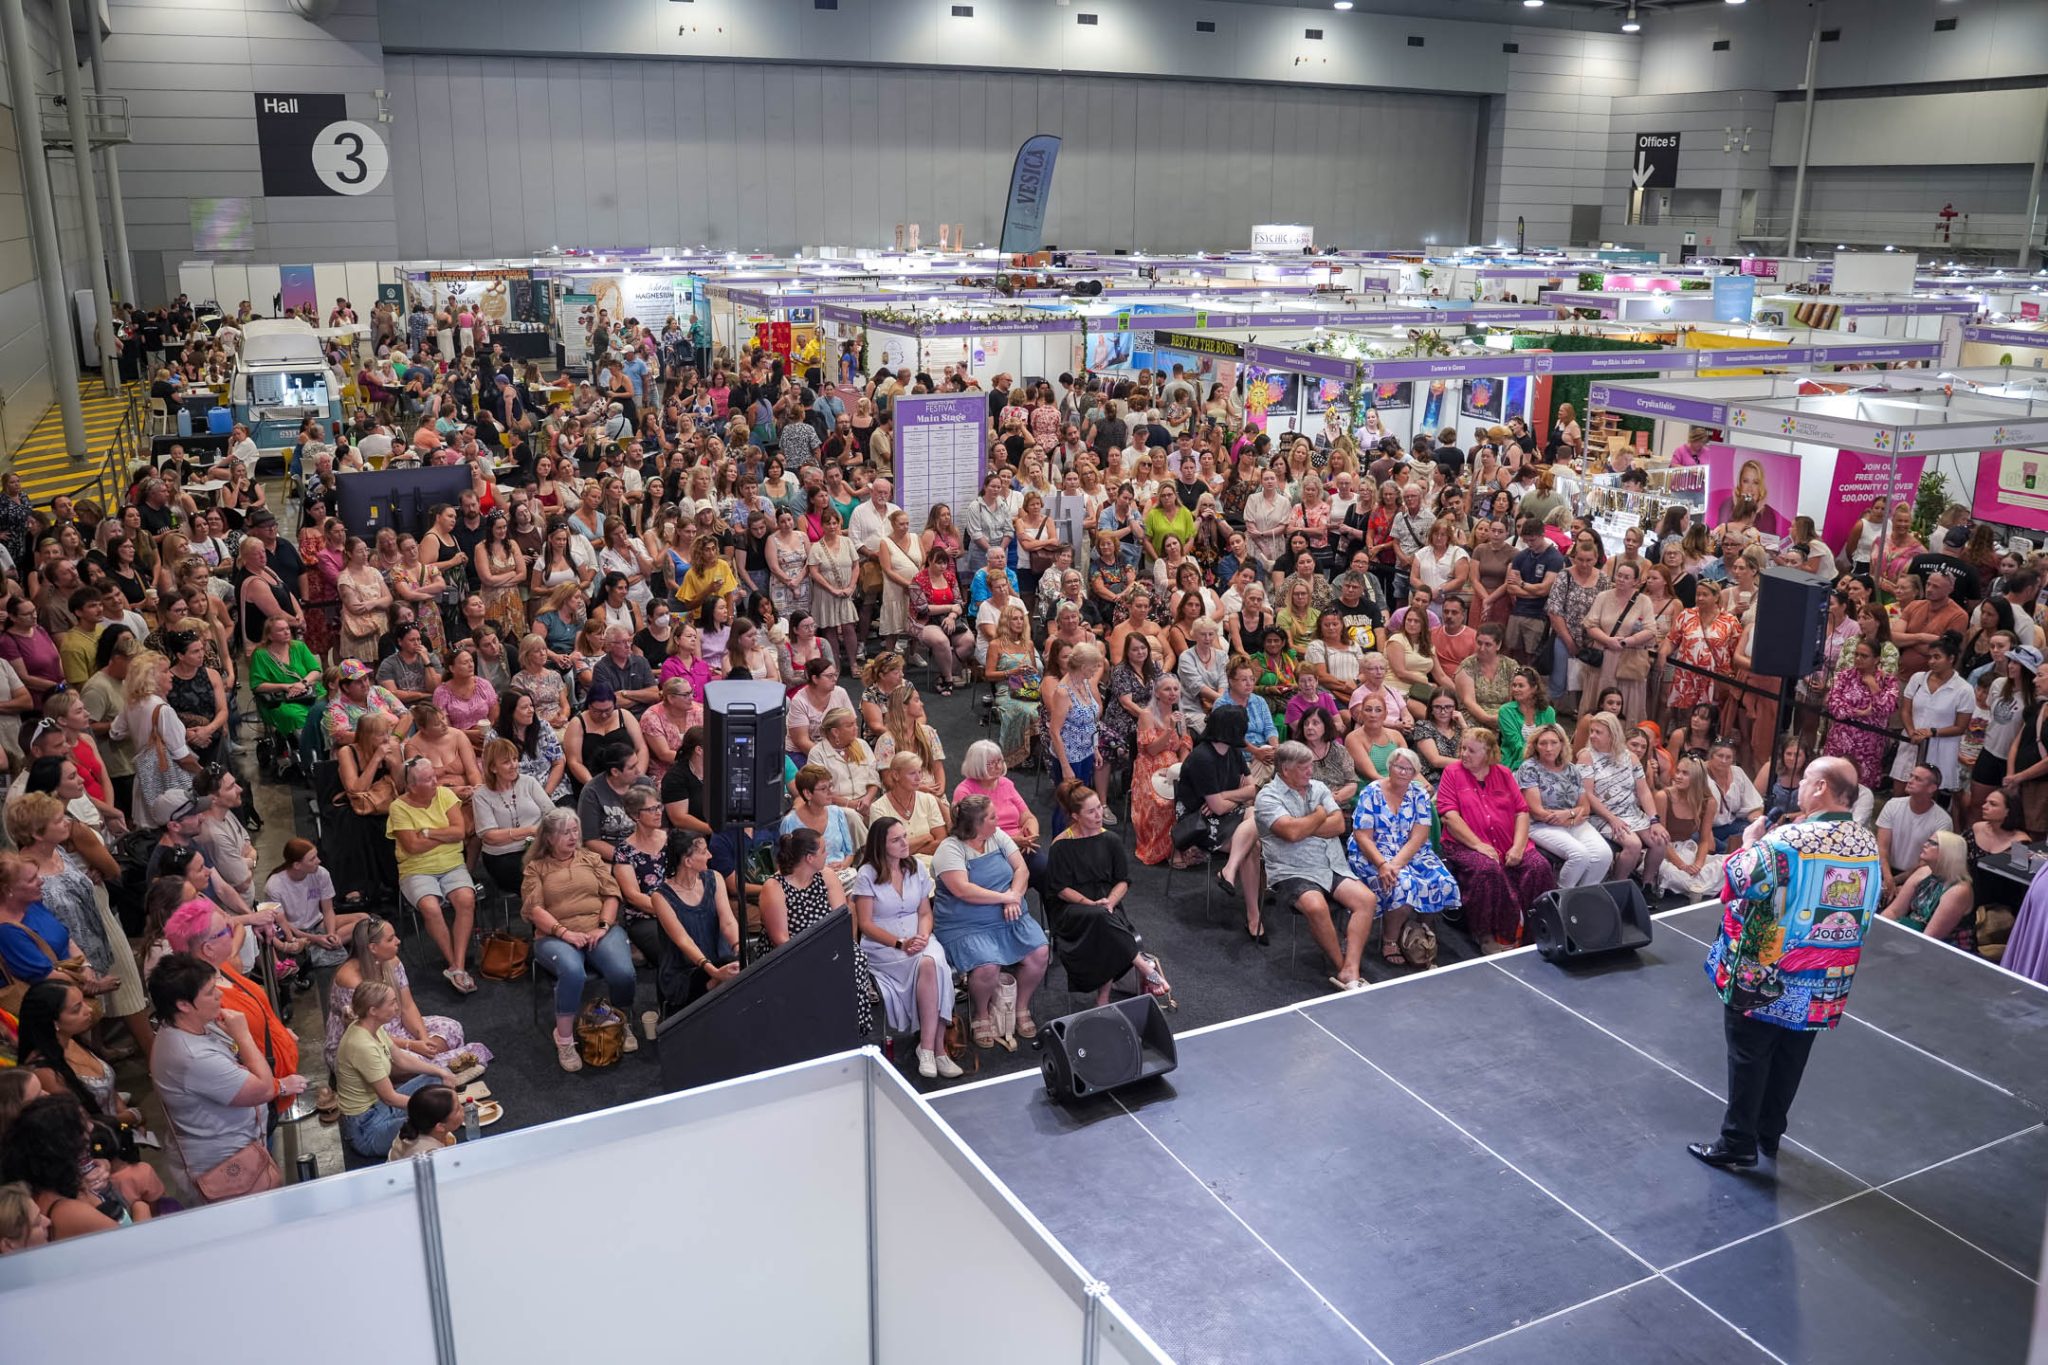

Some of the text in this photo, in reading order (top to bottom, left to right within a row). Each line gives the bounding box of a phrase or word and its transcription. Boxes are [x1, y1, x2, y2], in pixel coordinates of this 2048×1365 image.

[263, 98, 299, 114] Hall
[1639, 136, 1677, 148] Office 5
[333, 132, 368, 185] 3
[1016, 150, 1046, 204] VESICA
[1171, 334, 1189, 347] BEST
[1189, 337, 1199, 350] OF
[1200, 339, 1216, 352] THE
[925, 402, 957, 413] FESTIVAL
[916, 412, 967, 423] Main Stage
[1862, 463, 1881, 471] JOIN
[1854, 473, 1903, 481] FREE ONLNE
[1838, 483, 1882, 492] COMMUNITY
[1841, 493, 1874, 502] 500,000
